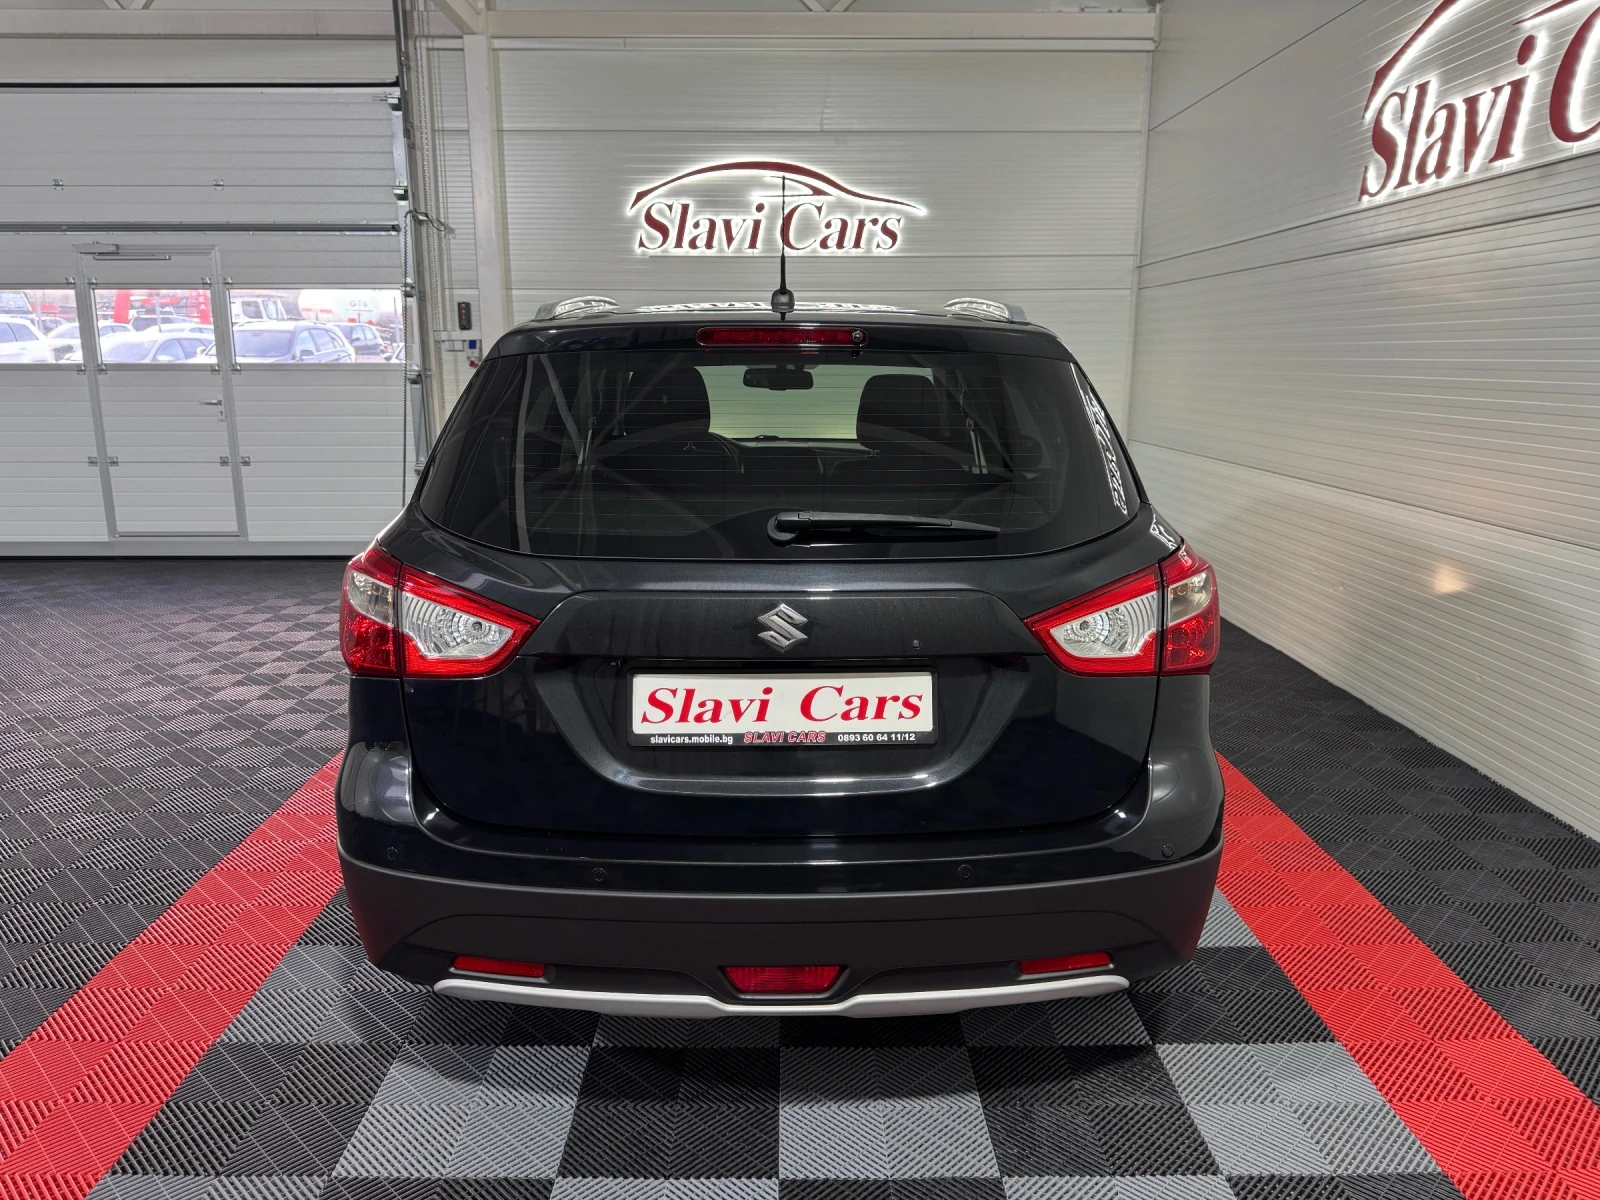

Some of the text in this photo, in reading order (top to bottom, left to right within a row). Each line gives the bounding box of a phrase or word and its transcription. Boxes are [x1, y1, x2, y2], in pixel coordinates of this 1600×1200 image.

[1358, 34, 1536, 202] Slavi
[638, 201, 902, 251] Slavi Cars
[641, 685, 923, 724] Slavi Cars
[650, 731, 917, 745] slavicars.mobile.bg SLAVI CARS 0893 60 64 11/12
